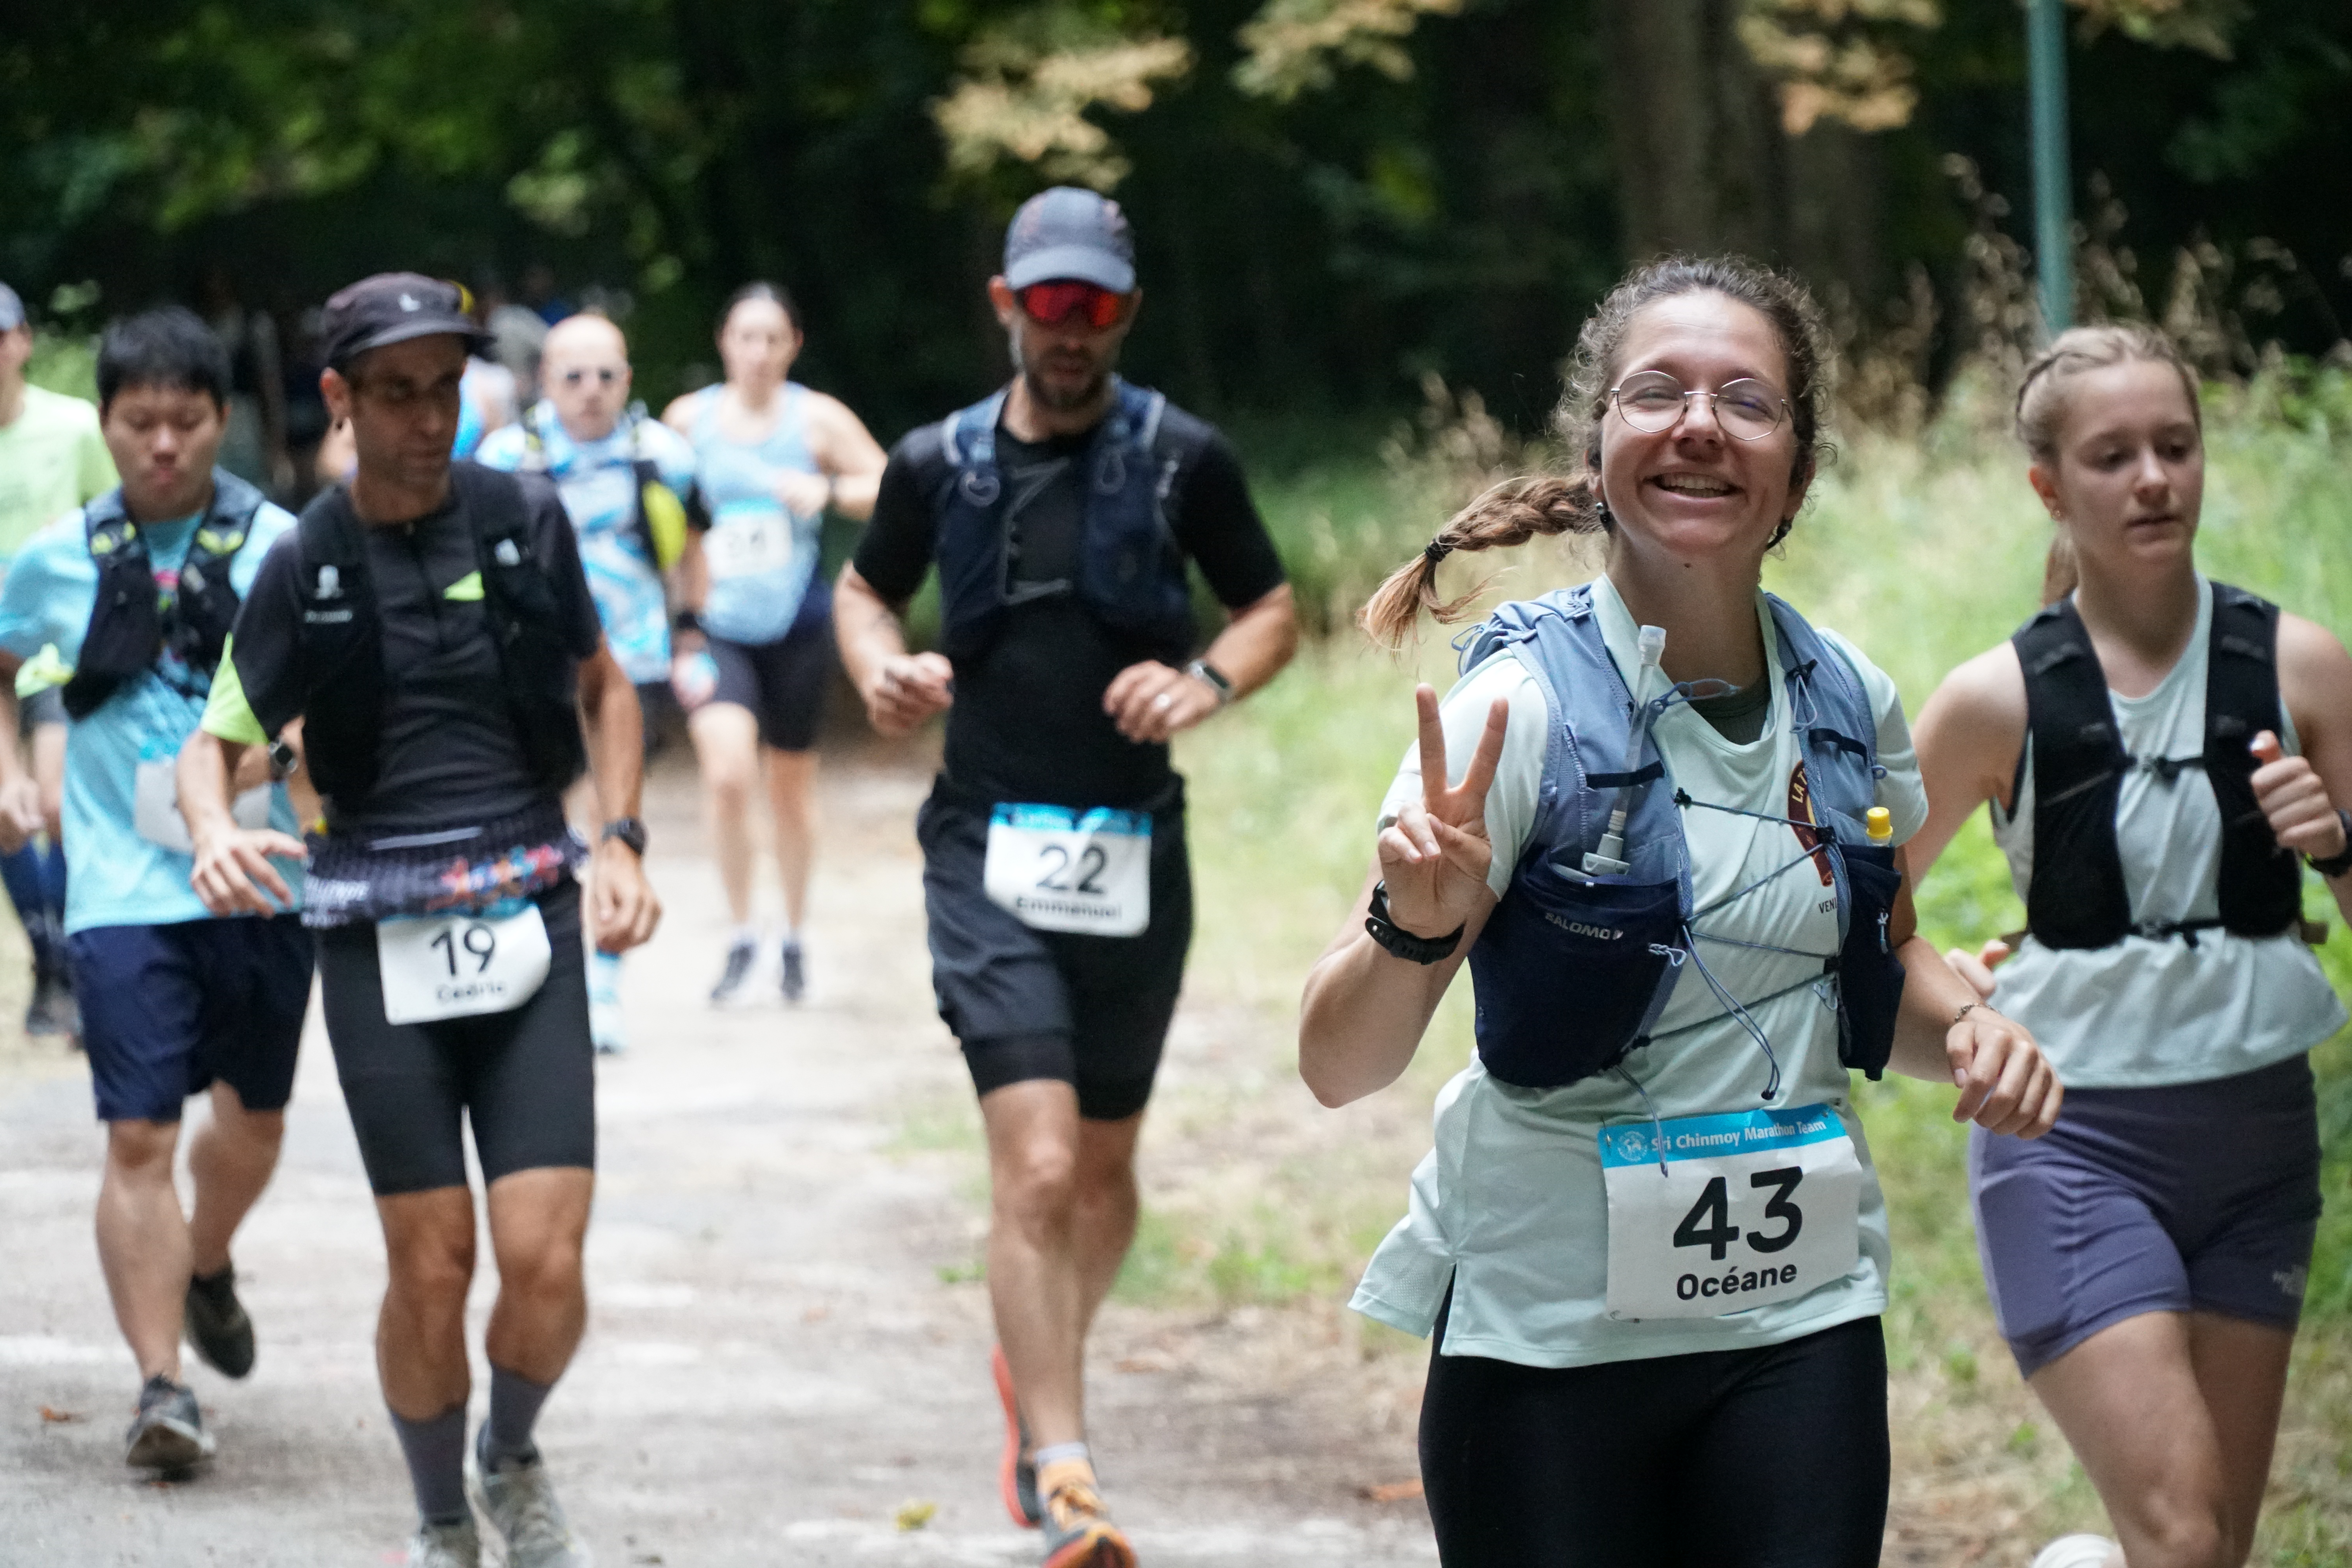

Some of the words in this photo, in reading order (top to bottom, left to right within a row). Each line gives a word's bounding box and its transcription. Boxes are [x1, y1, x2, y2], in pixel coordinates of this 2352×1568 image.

[1792, 783, 1805, 803] LA
[1036, 843, 1108, 894] 22
[431, 923, 495, 976] 19
[1676, 1131, 1740, 1149] Chinmoy
[1744, 1125, 1795, 1141] Marathon
[1798, 1121, 1826, 1134] Team
[1673, 1166, 1803, 1260] 43
[1677, 1263, 1797, 1300] Océane
